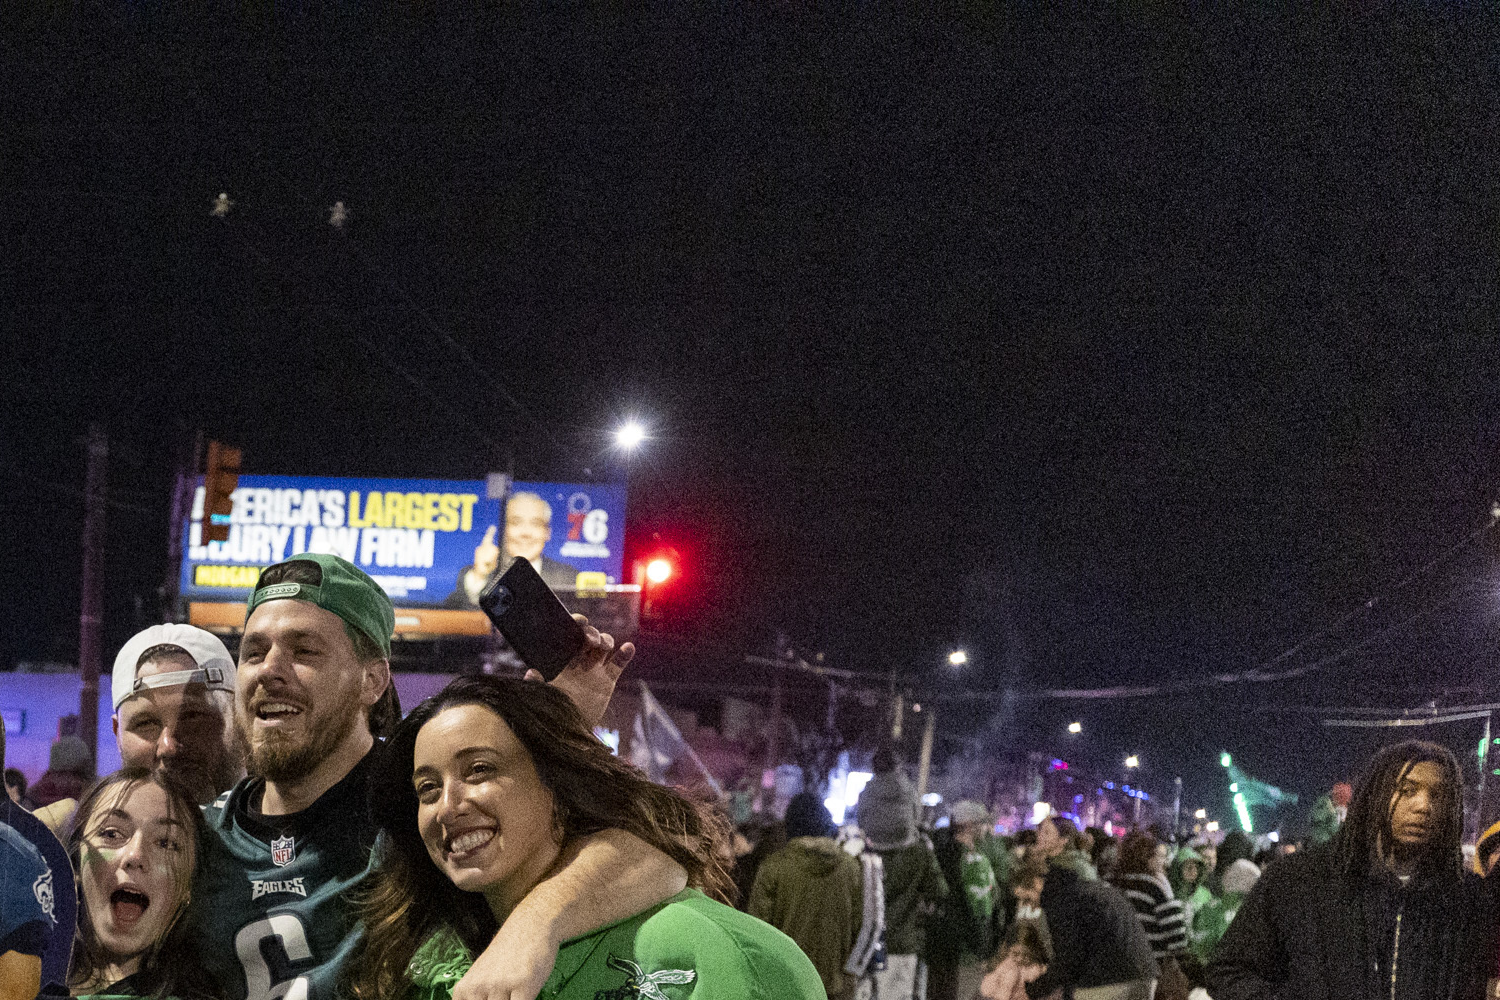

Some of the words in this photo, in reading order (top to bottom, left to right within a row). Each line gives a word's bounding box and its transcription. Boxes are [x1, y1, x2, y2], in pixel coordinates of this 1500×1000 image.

[191, 487, 346, 527] ERICA'S
[349, 491, 479, 532] LARGEST
[566, 508, 609, 545] 76
[189, 521, 290, 562] IURY
[360, 528, 435, 568] FIRM
[251, 877, 307, 900] EAGLES
